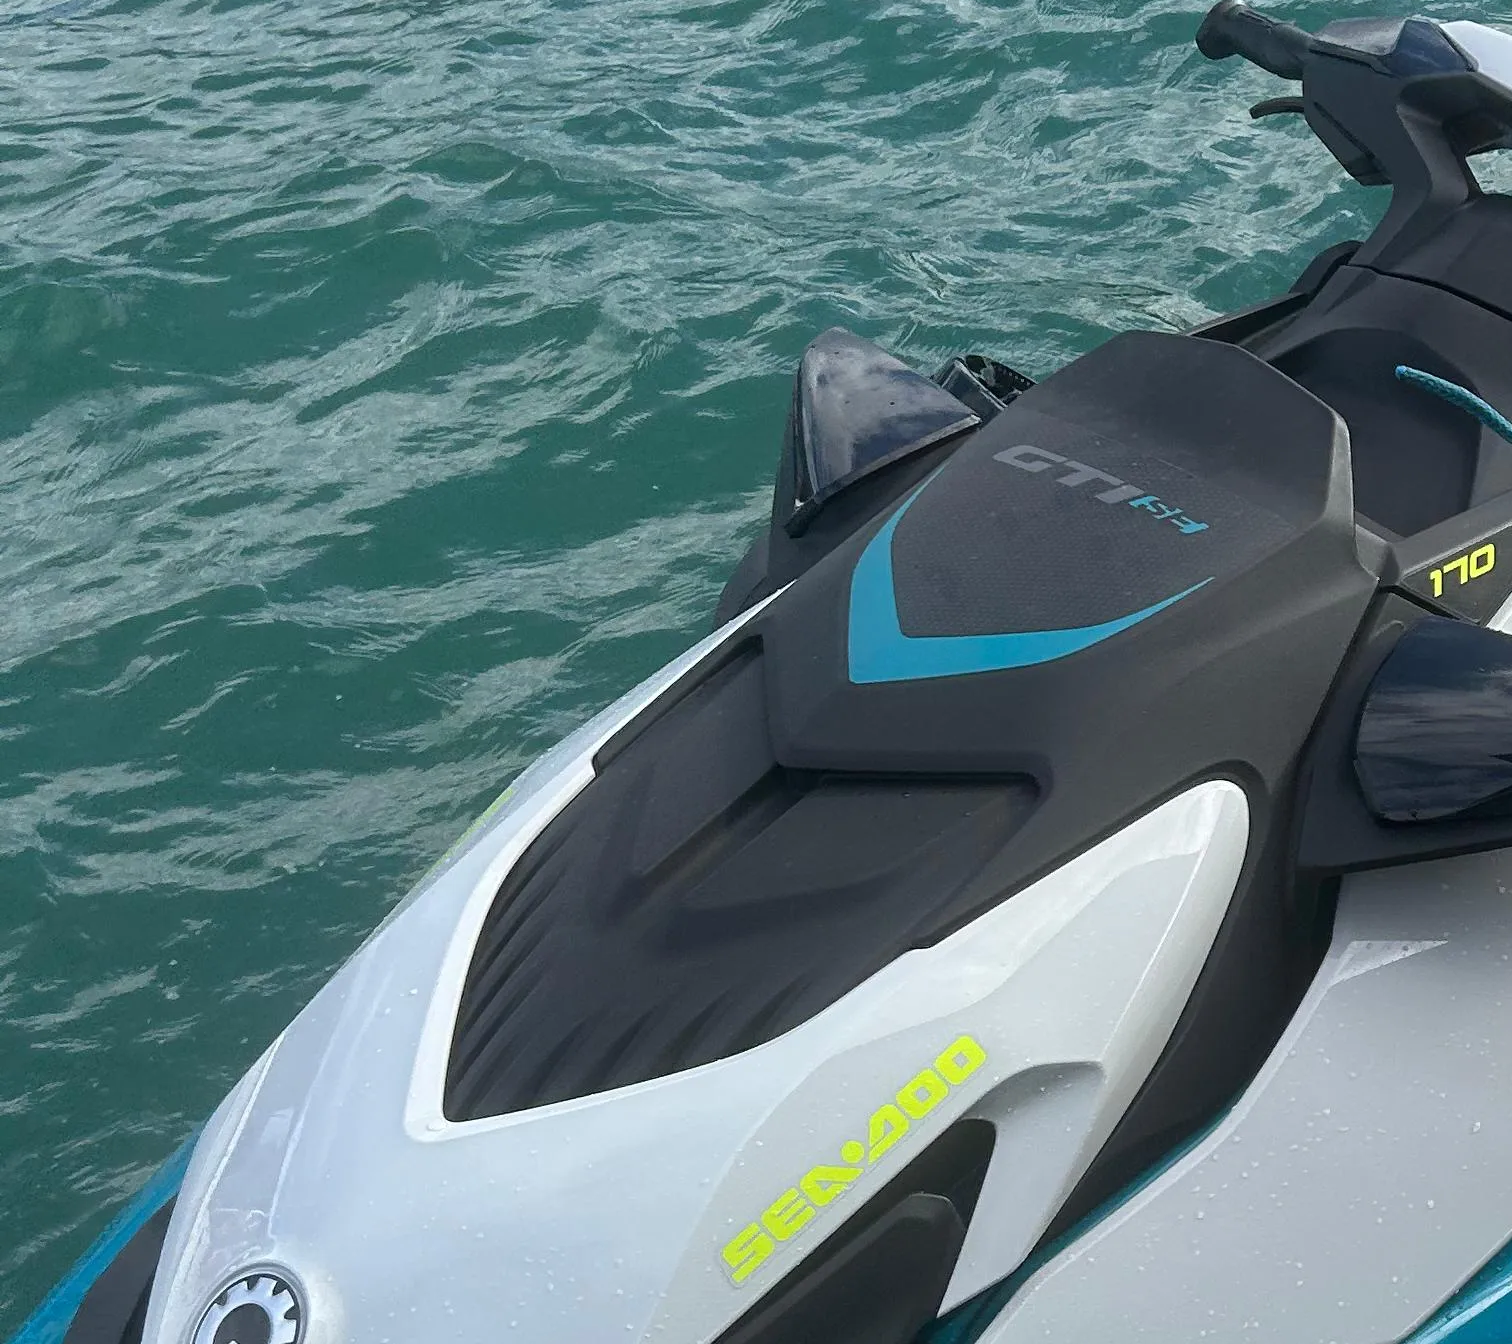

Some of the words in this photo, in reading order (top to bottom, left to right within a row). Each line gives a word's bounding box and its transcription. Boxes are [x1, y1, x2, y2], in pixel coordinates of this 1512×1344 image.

[991, 444, 1146, 505] GTI
[1127, 495, 1210, 535] SE
[1429, 543, 1496, 598] 170
